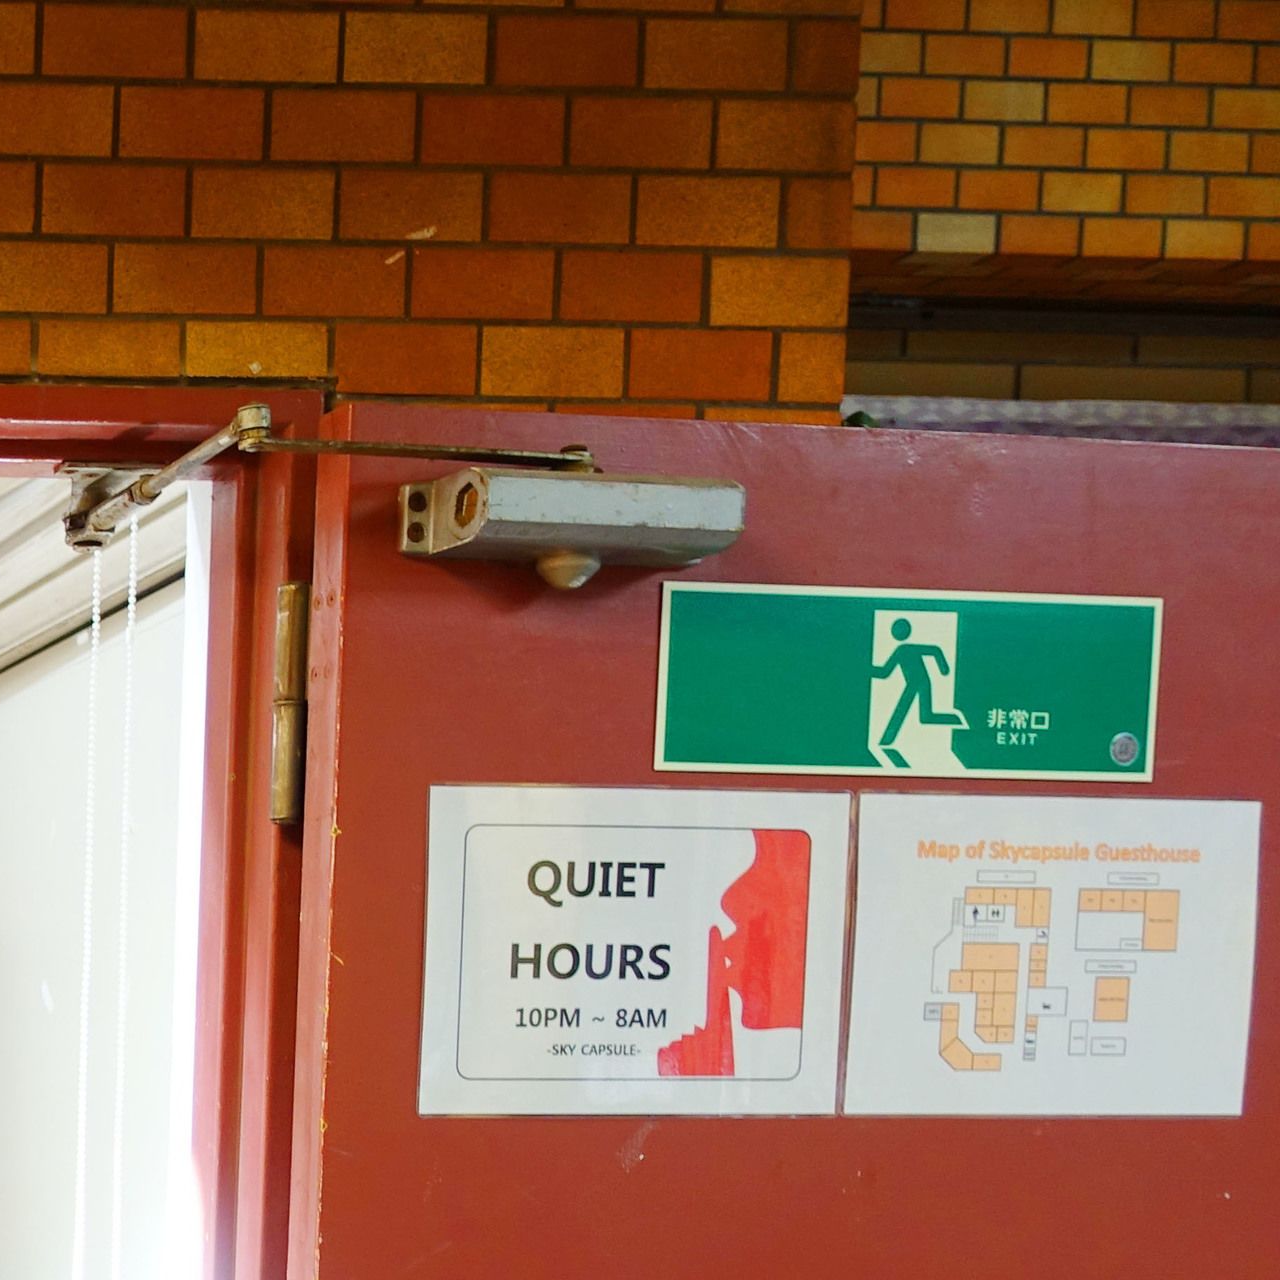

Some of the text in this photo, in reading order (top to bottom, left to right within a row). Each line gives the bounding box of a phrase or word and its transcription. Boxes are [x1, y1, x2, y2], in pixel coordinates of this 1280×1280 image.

[987, 708, 1050, 730] 非常口
[996, 731, 1038, 746] EXIT
[917, 840, 1201, 864] Map of Skycapsule Guesthouse
[527, 860, 666, 907] QUIET
[510, 943, 671, 980] HOURS
[515, 1008, 581, 1028] 10PM
[615, 1008, 668, 1028] 8AM
[547, 1044, 641, 1057] -SKY CAPSULE-
